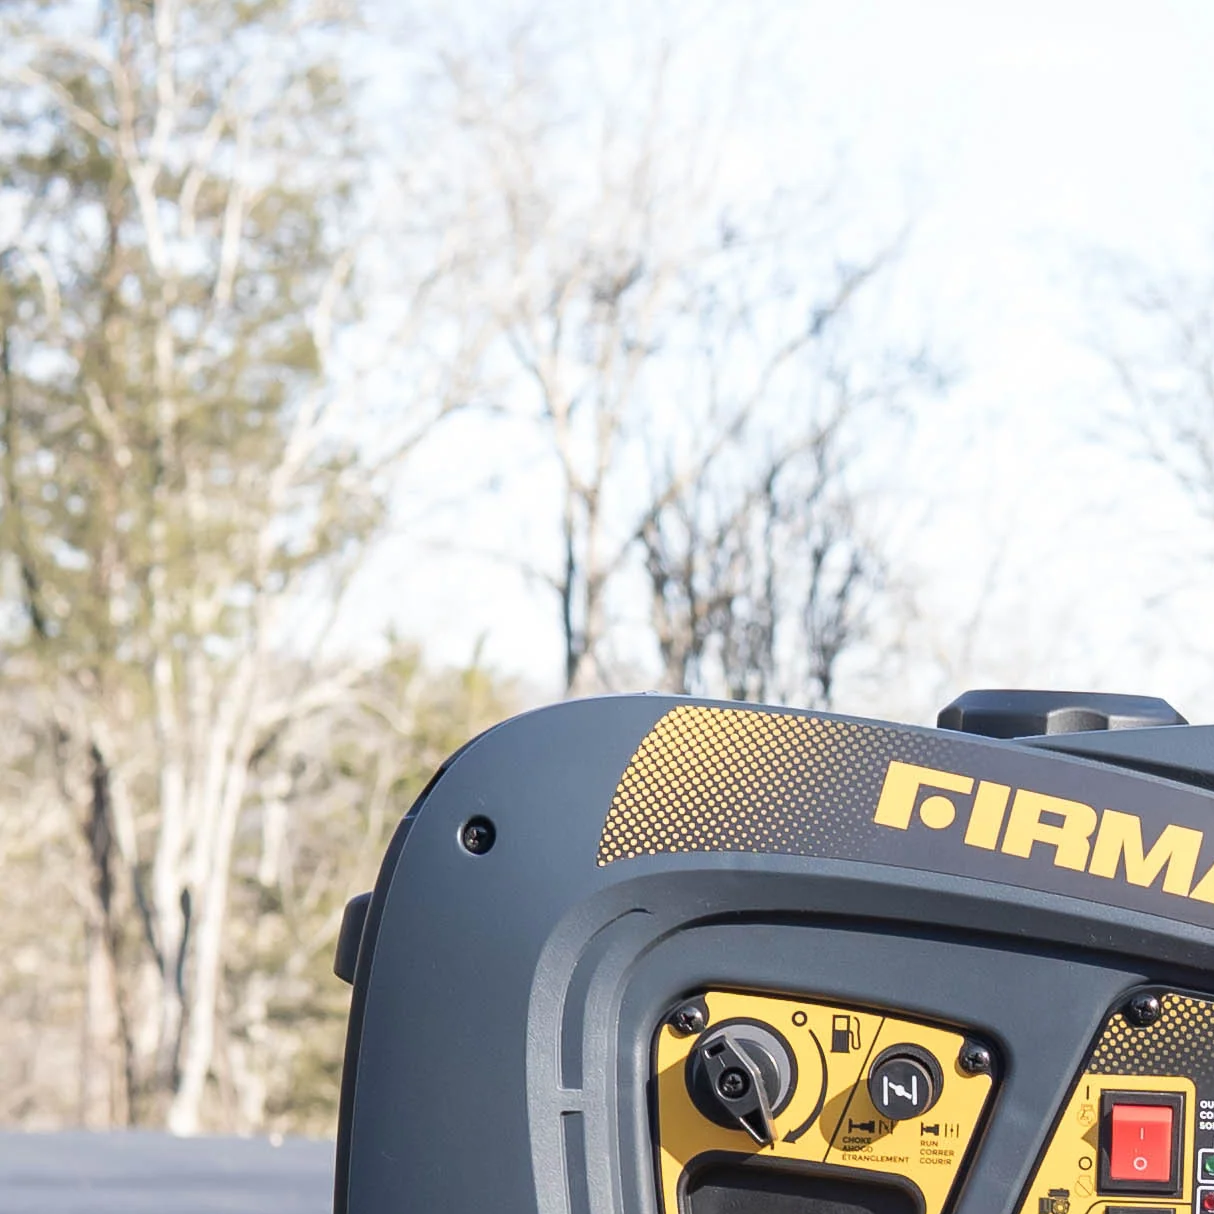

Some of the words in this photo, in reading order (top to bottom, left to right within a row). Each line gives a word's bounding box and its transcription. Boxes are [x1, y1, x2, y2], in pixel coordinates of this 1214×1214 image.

[842, 1136, 872, 1144] CHOKE
[919, 1148, 955, 1156] CORRER
[919, 1157, 952, 1165] COURIR
